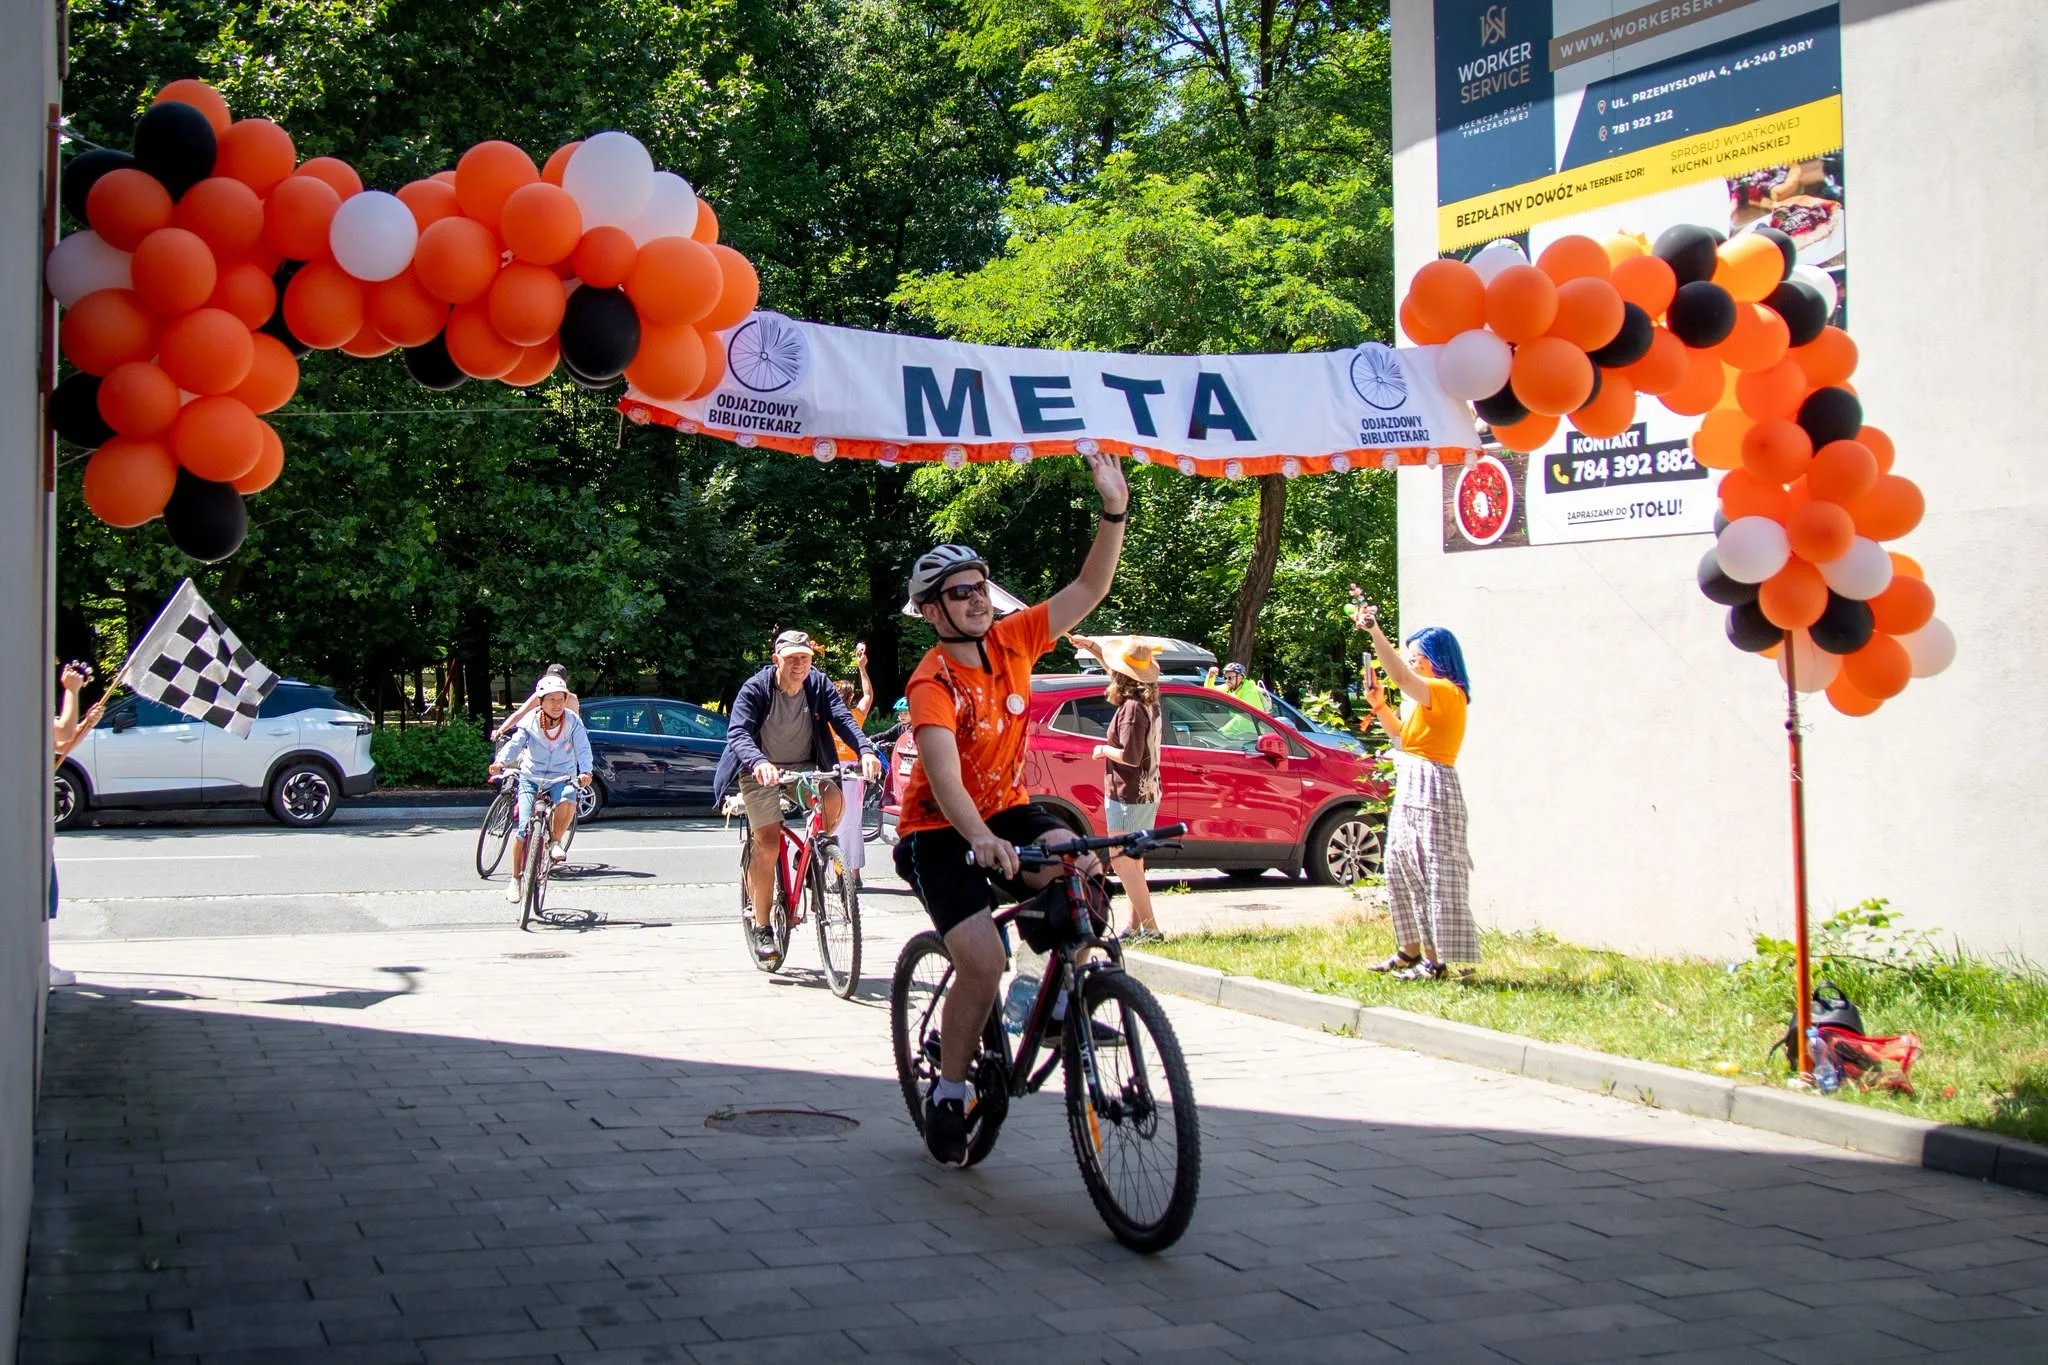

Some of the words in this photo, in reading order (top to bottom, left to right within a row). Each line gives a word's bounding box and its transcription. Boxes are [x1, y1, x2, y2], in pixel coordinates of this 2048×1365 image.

[1458, 41, 1532, 83] WORKER
[1612, 98, 1629, 109] UL.
[1632, 70, 1716, 103] PRZEMYSŁOWA
[1719, 66, 1731, 76] 4,
[1734, 50, 1777, 71] 44-240
[1779, 38, 1814, 58] ŻORY
[1461, 64, 1530, 104] SERVICE
[1458, 112, 1499, 131] AGENCJA
[1503, 101, 1533, 116] PRACY
[1462, 111, 1529, 138] TYMCZASOWEJ
[1612, 122, 1630, 135] 781
[1632, 115, 1652, 130] 922
[1654, 109, 1673, 124] 222
[1671, 155, 1713, 175] KUCHNI
[1456, 198, 1523, 228] BEZPŁATNY
[1526, 183, 1574, 209] DOWÓZ
[1575, 182, 1588, 193] NA
[1590, 173, 1623, 190] TERENIE
[717, 394, 799, 418] ODJAZDOWY
[902, 365, 1257, 441] META
[708, 409, 802, 434] BIBLIOTEKARZ
[1361, 415, 1423, 430] ODJAZDOWY
[1360, 429, 1431, 445] BIBLIOTEKARZ
[1572, 457, 1609, 482] 784
[1613, 453, 1653, 478] 392
[1656, 448, 1696, 473] 882
[1567, 508, 1614, 520] ZAPRASZAMY
[1615, 507, 1627, 516] DO
[1630, 499, 1683, 519] STOŁU!
